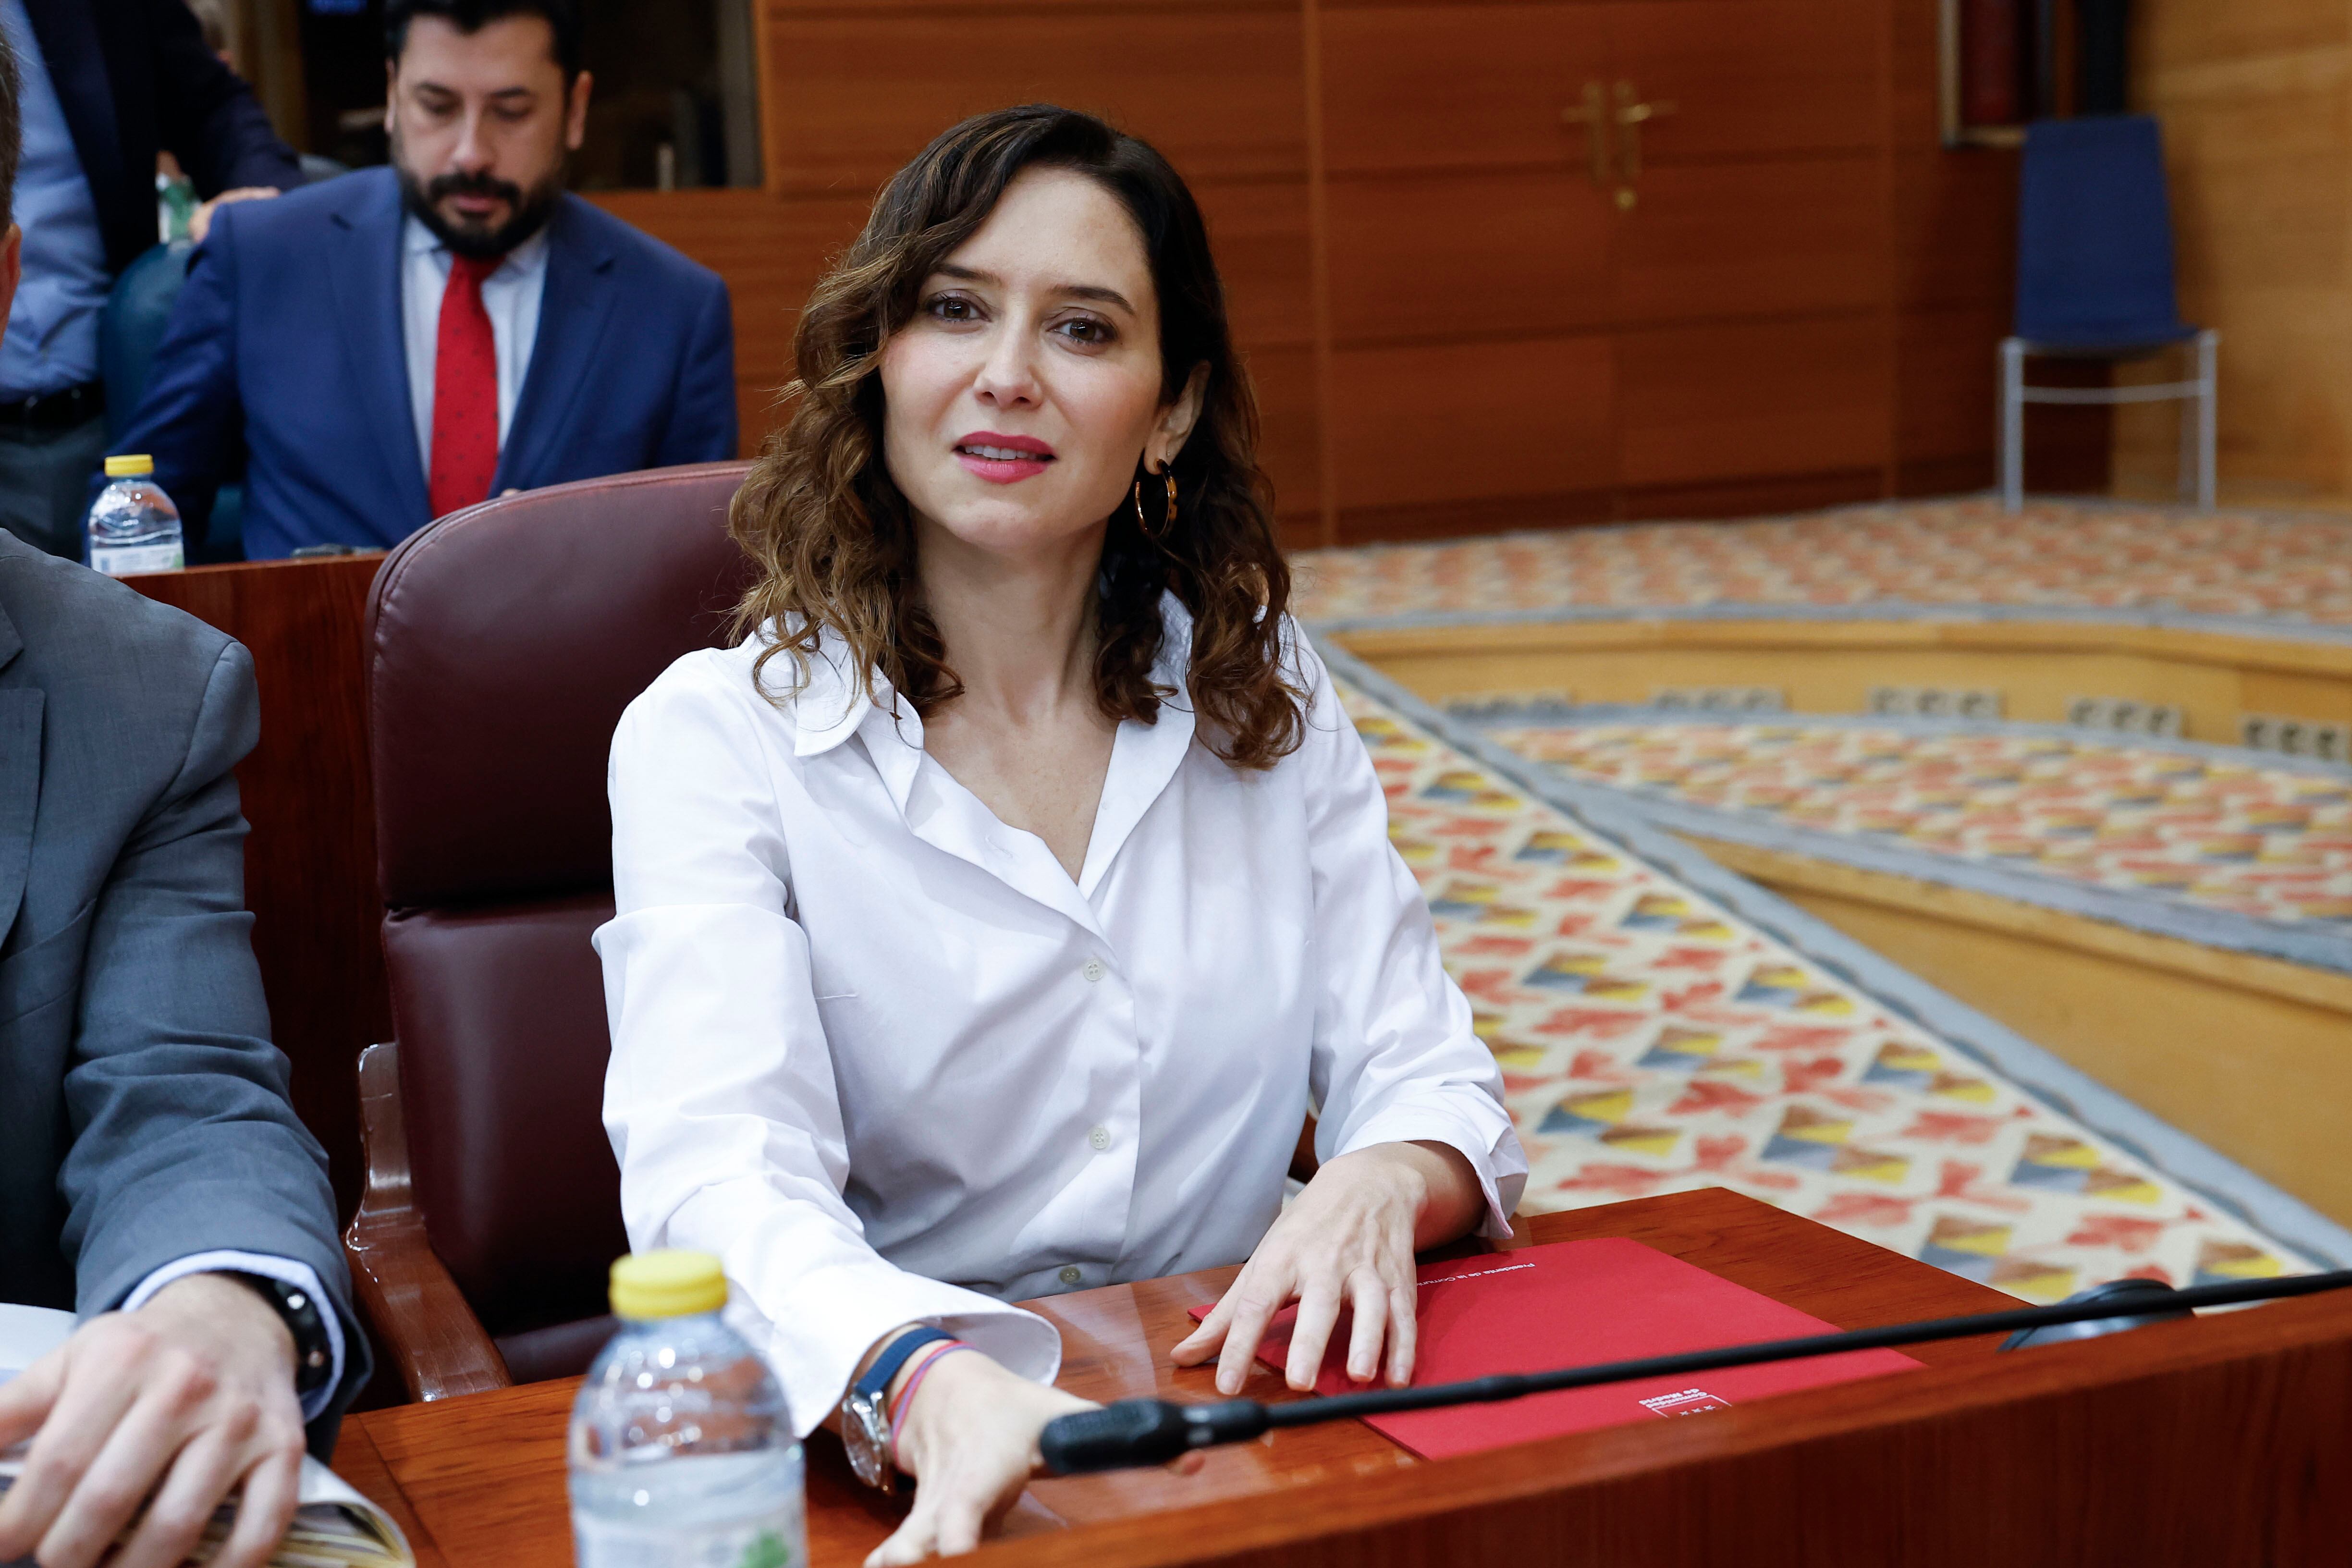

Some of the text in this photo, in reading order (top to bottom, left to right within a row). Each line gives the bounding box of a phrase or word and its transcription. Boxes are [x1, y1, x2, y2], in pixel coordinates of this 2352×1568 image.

[1482, 1263, 1535, 1274] Presidenta
[1638, 1392, 1683, 1405] Madrid
[1645, 1392, 1707, 1409] Comunidad
